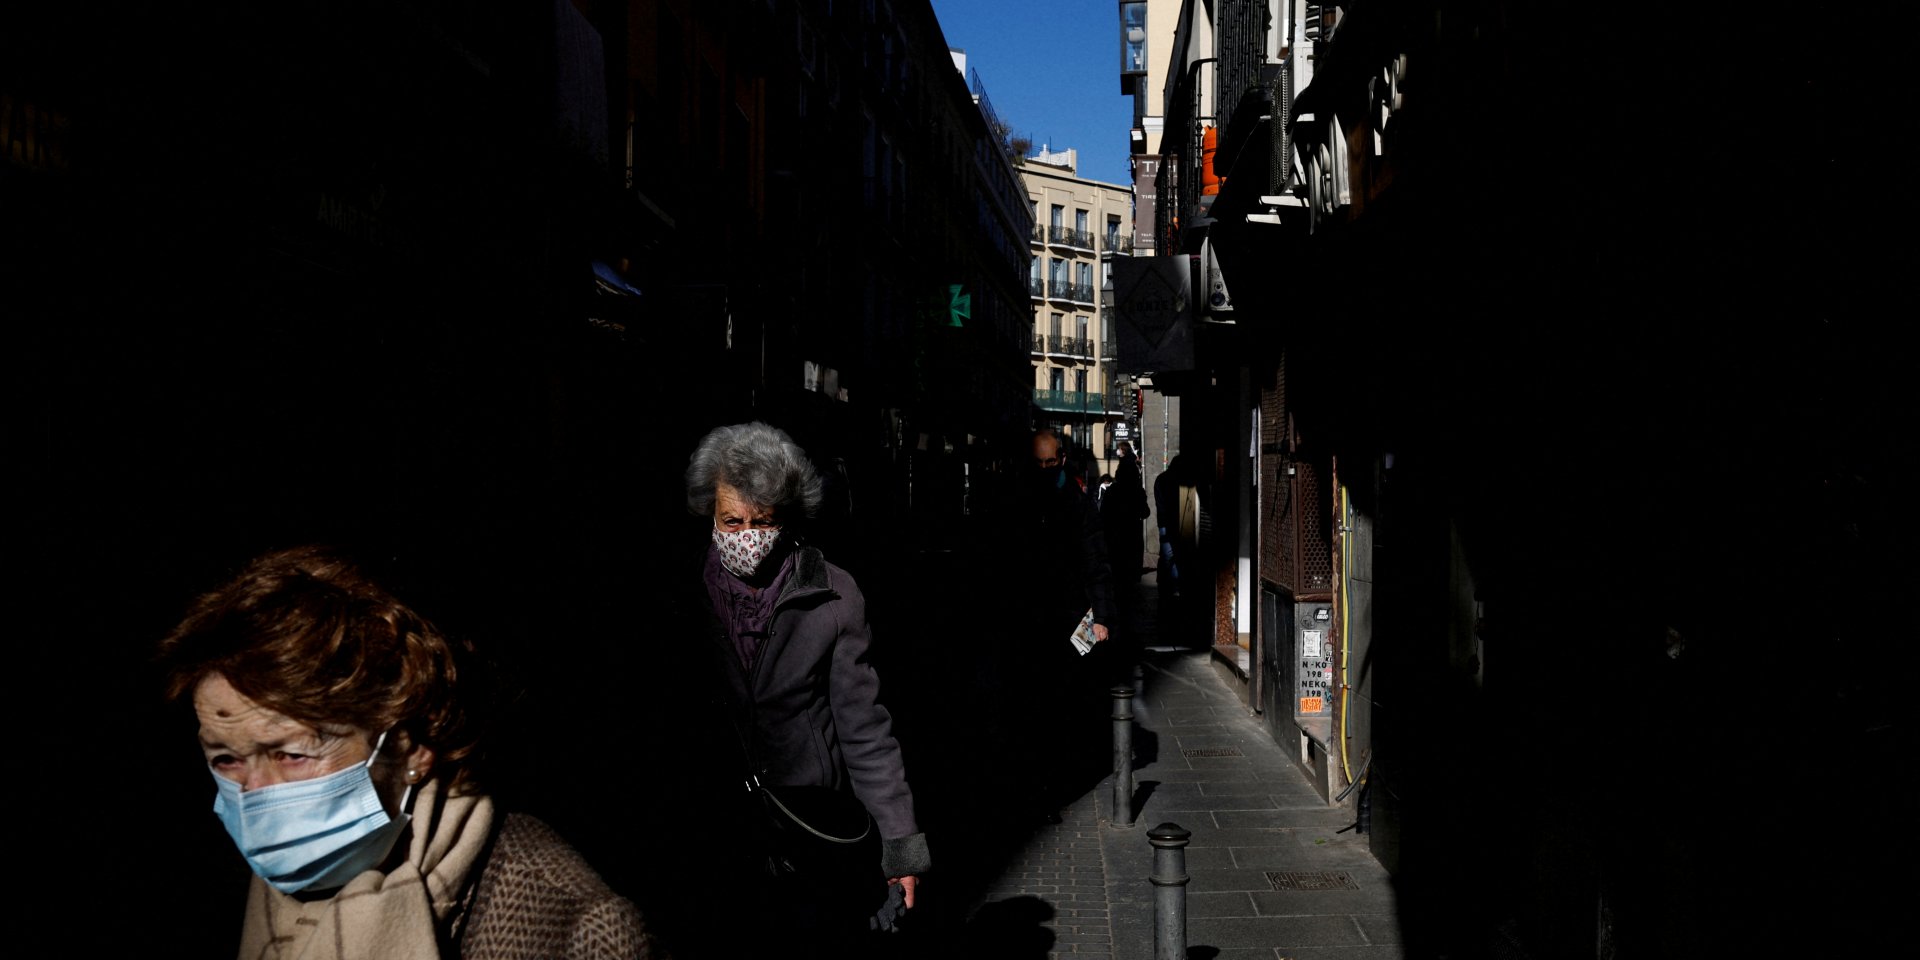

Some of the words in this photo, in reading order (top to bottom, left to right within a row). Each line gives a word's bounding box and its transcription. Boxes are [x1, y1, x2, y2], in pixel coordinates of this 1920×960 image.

[1306, 670, 1322, 678] 198
[1301, 680, 1327, 688] NEKO
[1306, 689, 1321, 697] 198
